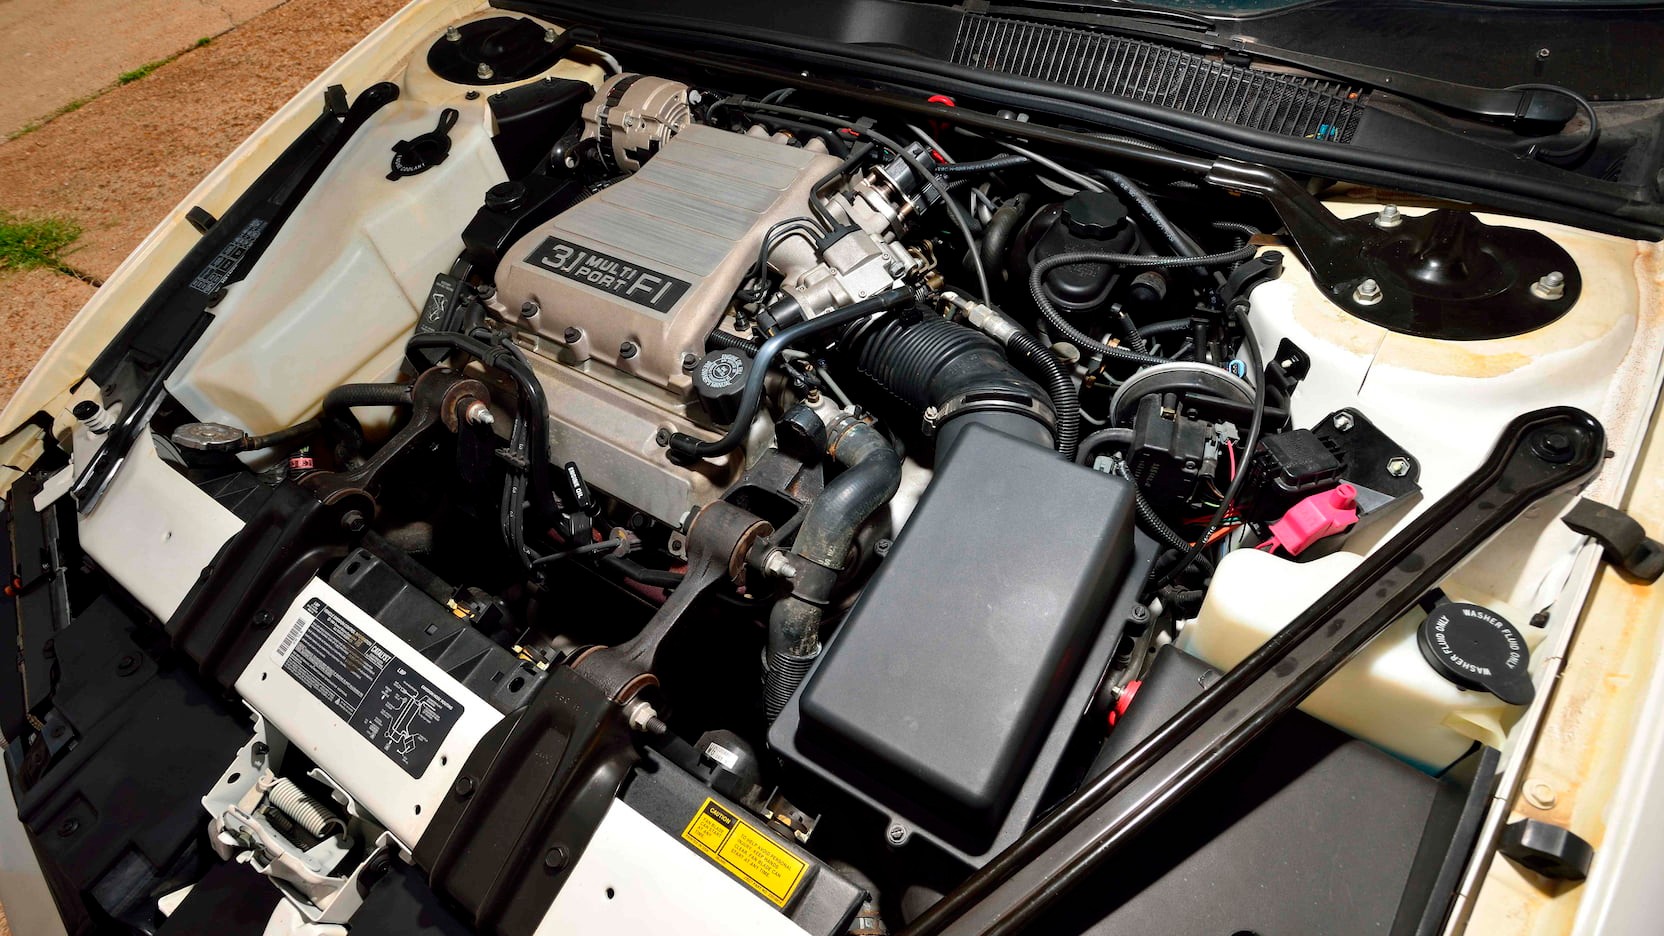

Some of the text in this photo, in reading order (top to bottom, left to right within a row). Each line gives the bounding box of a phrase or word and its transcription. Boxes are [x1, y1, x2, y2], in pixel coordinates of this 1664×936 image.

[574, 266, 627, 292] PORT
[585, 255, 638, 280] MULTI
[626, 272, 672, 305] FI
[568, 466, 584, 499] ENGINE OIL
[1434, 614, 1492, 676] WASHER FLUID ONLY
[1462, 608, 1520, 670] WASHER FLUID ONLY
[702, 817, 724, 833] FAN BLADE
[708, 806, 731, 824] CAUTION
[699, 821, 721, 838] CAN START
[730, 848, 744, 859] START
[749, 861, 759, 870] ANY
[746, 837, 757, 847] HELP
[756, 845, 770, 856] AVOID
[769, 854, 791, 870] PERSONAL
[747, 853, 758, 862] FAN
[757, 859, 771, 871] BLADE
[771, 869, 781, 878] CAN
[752, 849, 763, 858] KEEP
[763, 856, 779, 869] HANDS
